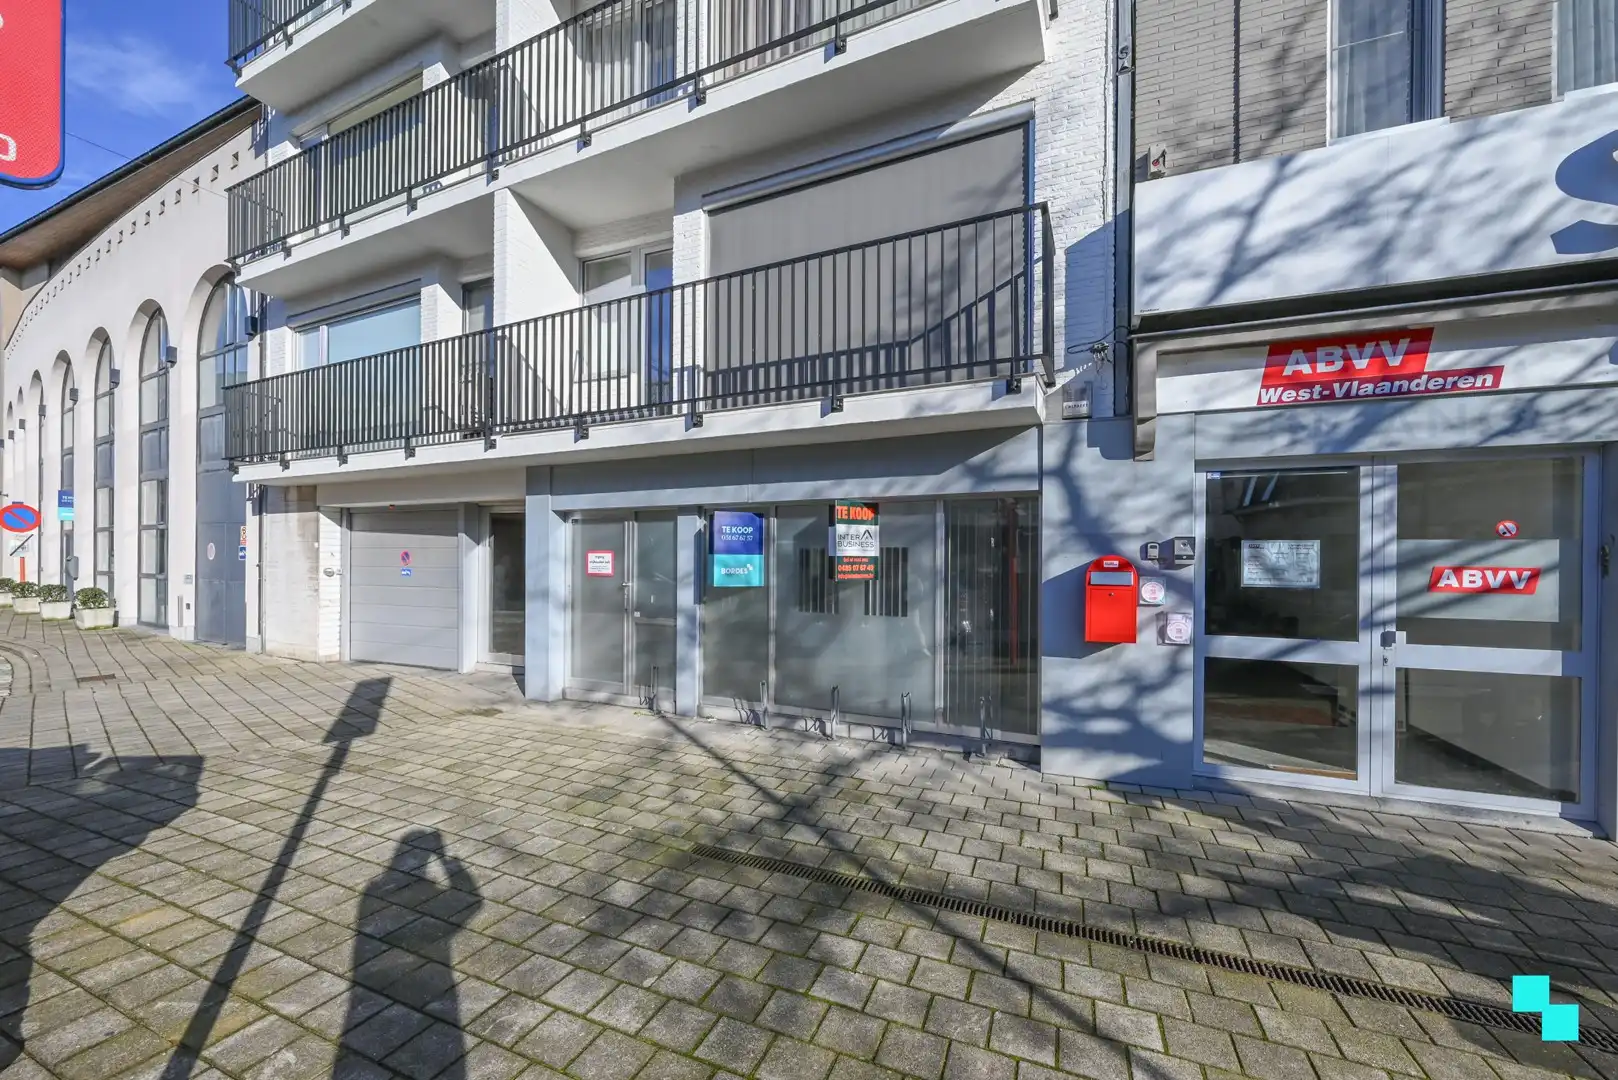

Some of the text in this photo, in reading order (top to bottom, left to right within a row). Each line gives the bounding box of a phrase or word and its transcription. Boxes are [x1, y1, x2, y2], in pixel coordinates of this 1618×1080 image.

[1282, 338, 1411, 377] ABVV
[1260, 373, 1494, 404] West-Vlaanderen
[836, 505, 875, 521] TE KOOP
[721, 525, 754, 534] TE KOOP
[837, 533, 861, 541] INTER
[837, 541, 875, 549] BUSINESS
[720, 567, 749, 575] BORDES
[1437, 568, 1532, 590] ABVV
